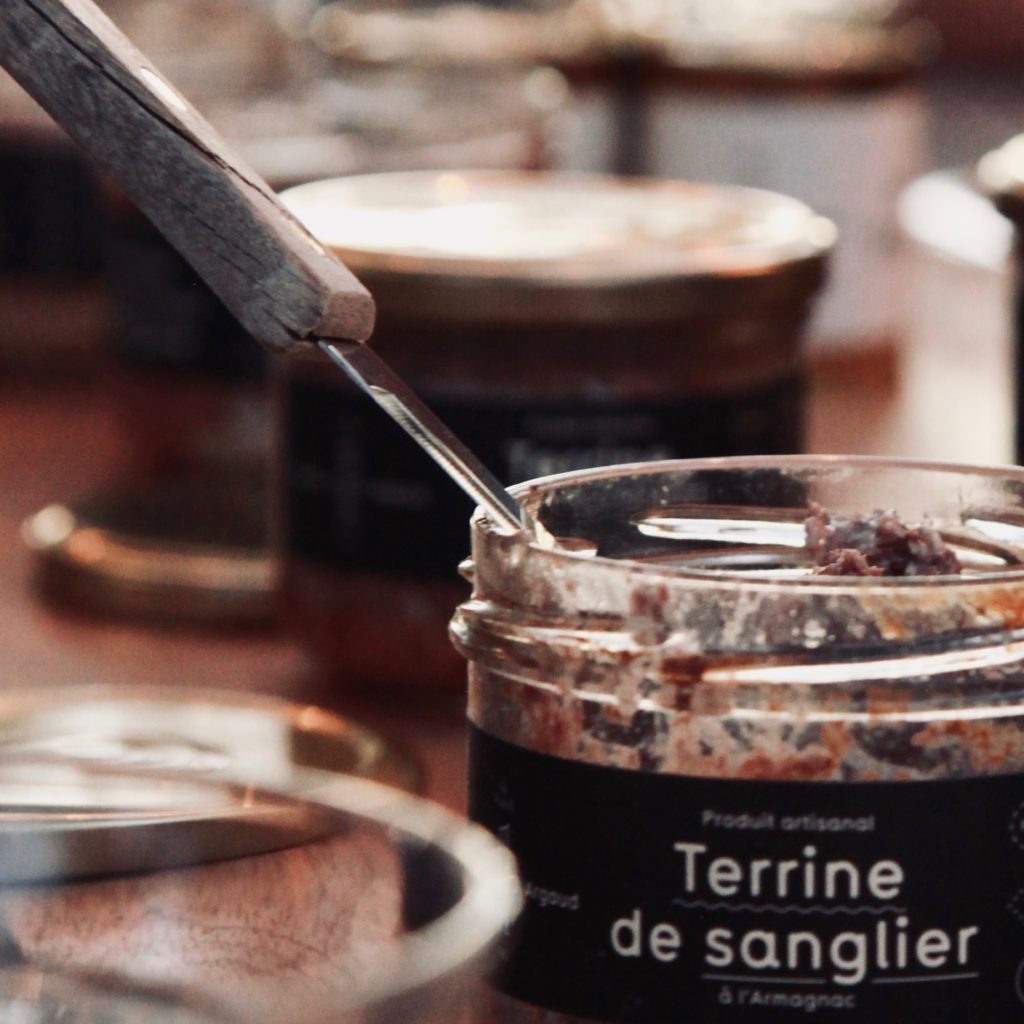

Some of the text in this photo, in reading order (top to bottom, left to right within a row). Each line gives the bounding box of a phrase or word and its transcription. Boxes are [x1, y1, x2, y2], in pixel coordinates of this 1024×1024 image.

[703, 809, 876, 833] Produit artisanal
[673, 841, 905, 899] Terrine
[610, 908, 980, 985] de sanglier
[718, 985, 856, 1013] à l'Armagnac
